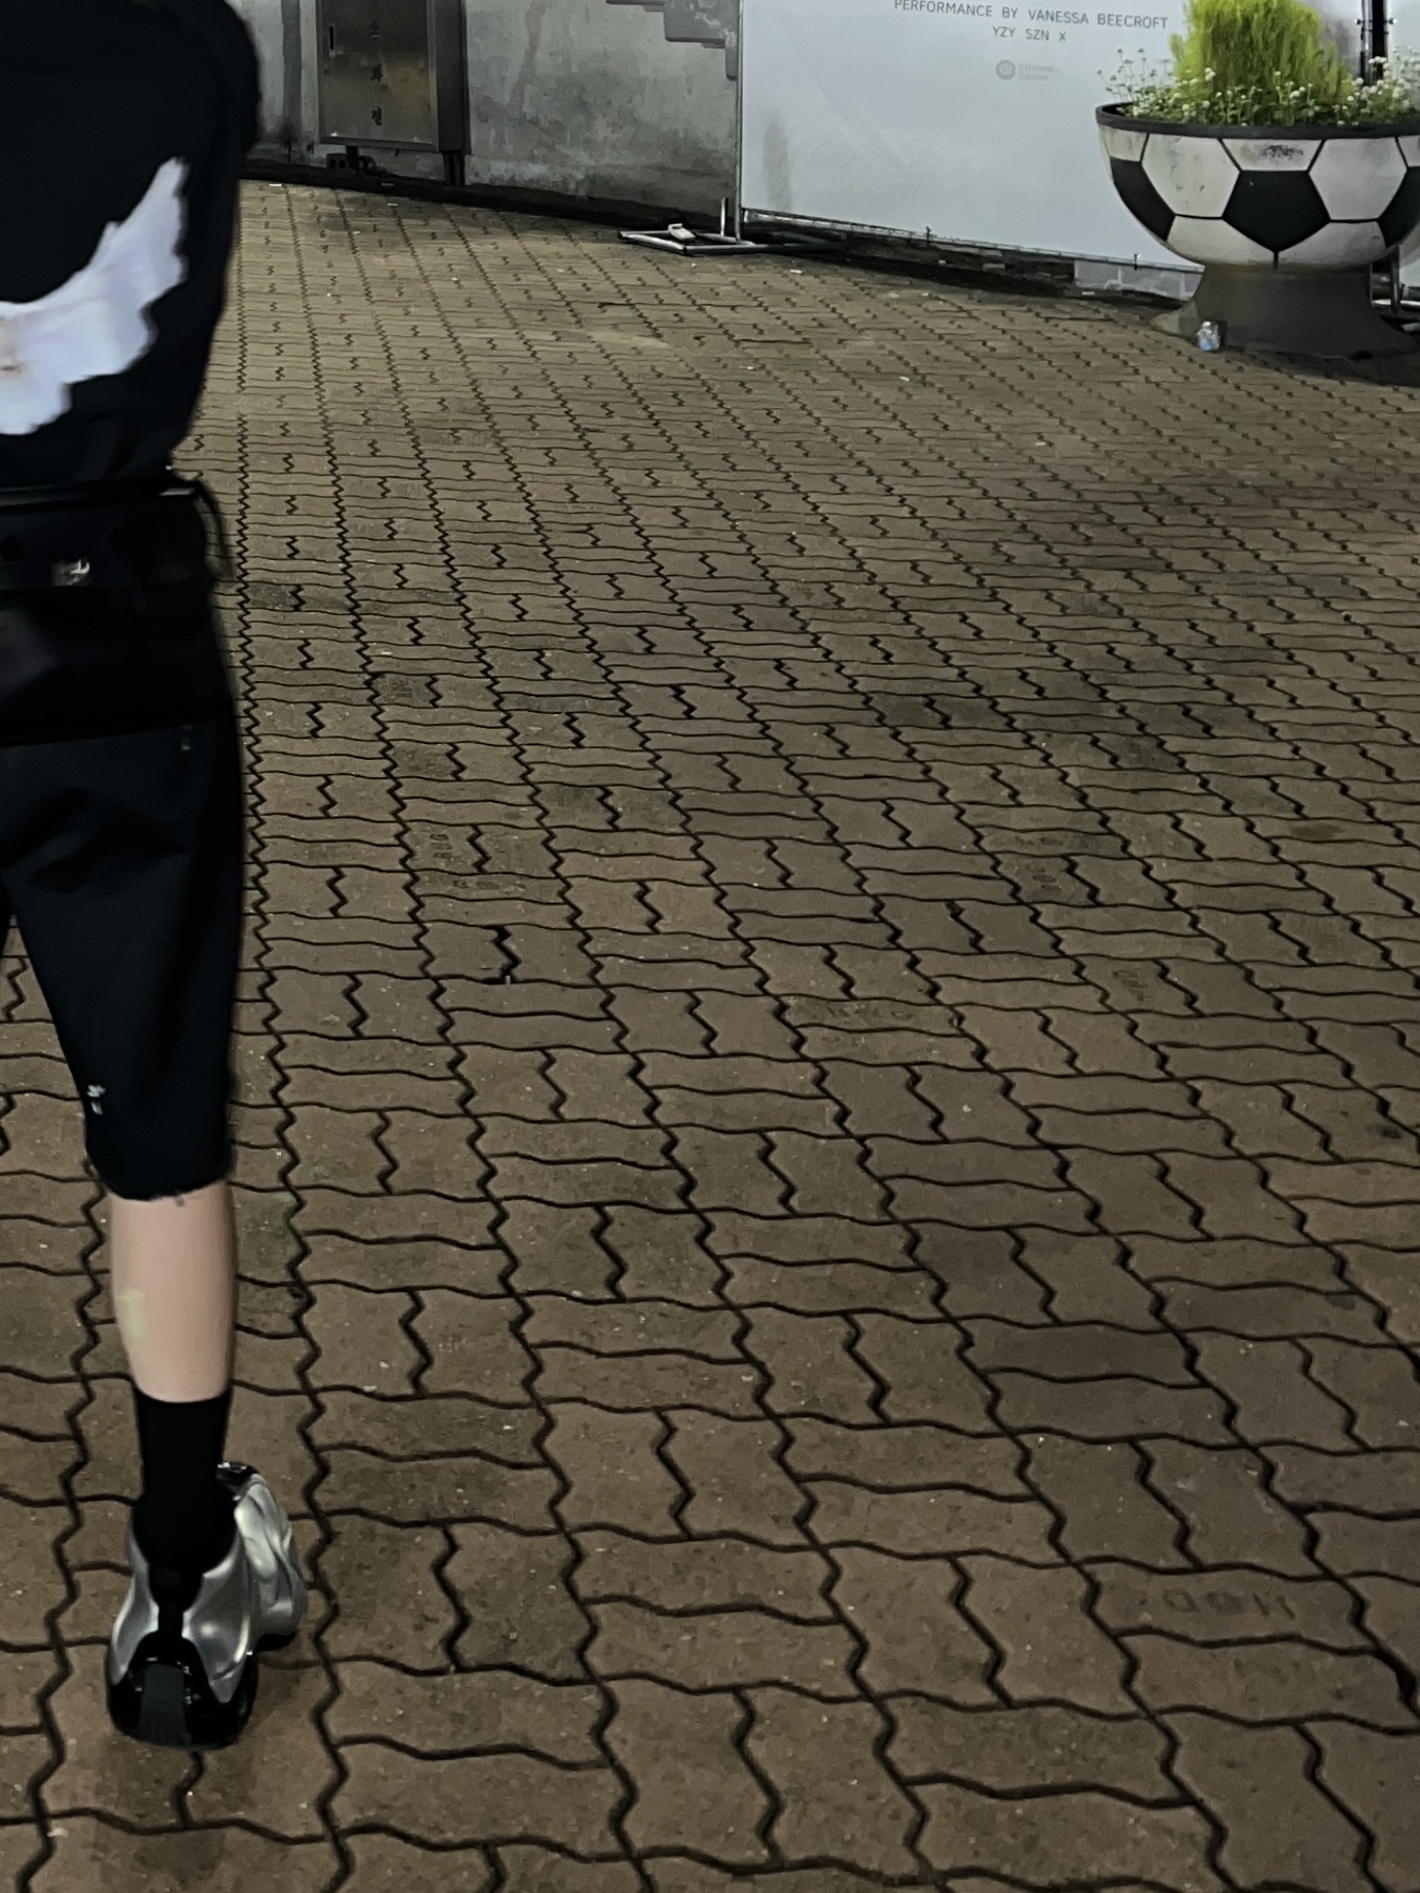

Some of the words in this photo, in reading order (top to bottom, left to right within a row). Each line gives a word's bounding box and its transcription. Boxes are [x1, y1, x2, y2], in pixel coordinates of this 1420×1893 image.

[1001, 6, 1019, 19] BY
[1028, 8, 1089, 25] VANESSA
[1097, 12, 1169, 29] BEECROFT
[992, 26, 1016, 38] YZY
[1025, 28, 1050, 41] SZN
[1058, 31, 1067, 42] X
